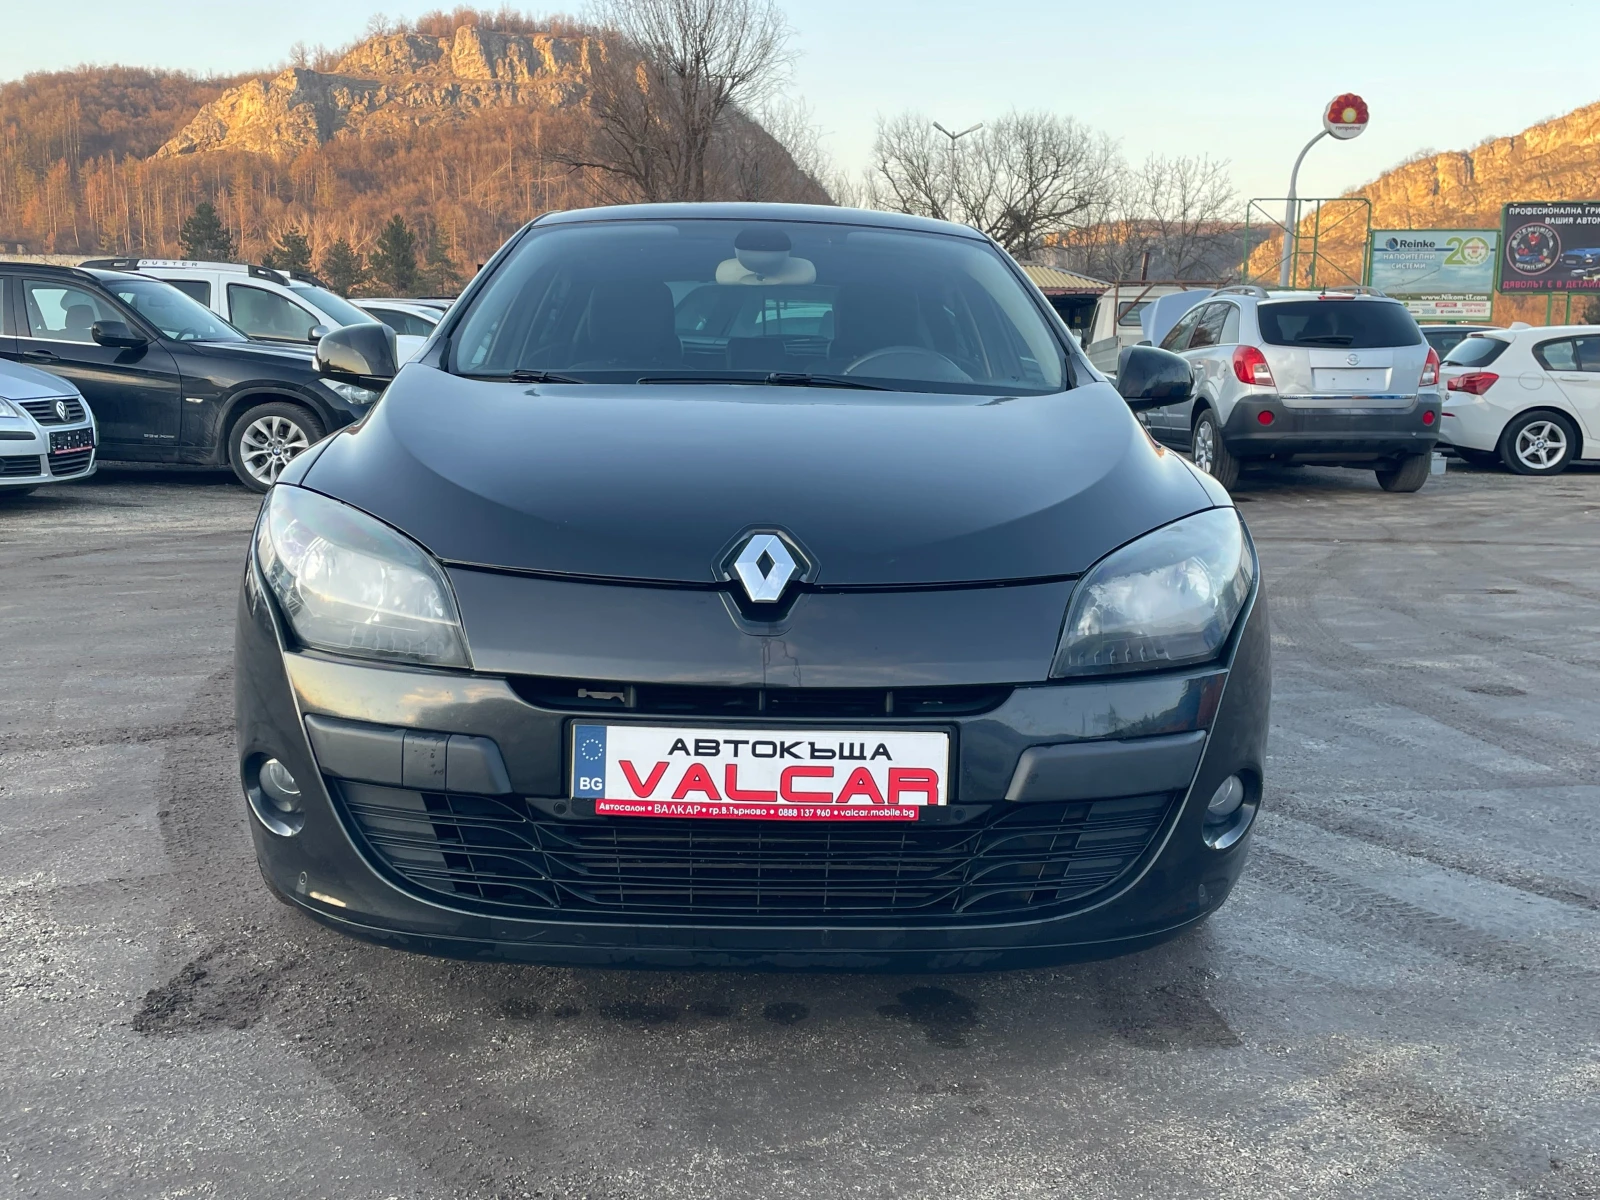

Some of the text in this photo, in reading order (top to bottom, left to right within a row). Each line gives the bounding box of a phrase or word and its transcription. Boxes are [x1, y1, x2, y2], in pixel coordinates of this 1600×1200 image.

[1509, 207, 1582, 215] ПРОФЕСИОНАЛНА
[1400, 240, 1435, 248] Reinke
[668, 737, 893, 761] АВТОКЪЩА
[580, 777, 603, 790] BG
[618, 760, 940, 806] VALCAR
[599, 802, 915, 818] Автосалон ВАЛКАР гр.В.Търново 0888 137 960 valcar.mobile.bg
